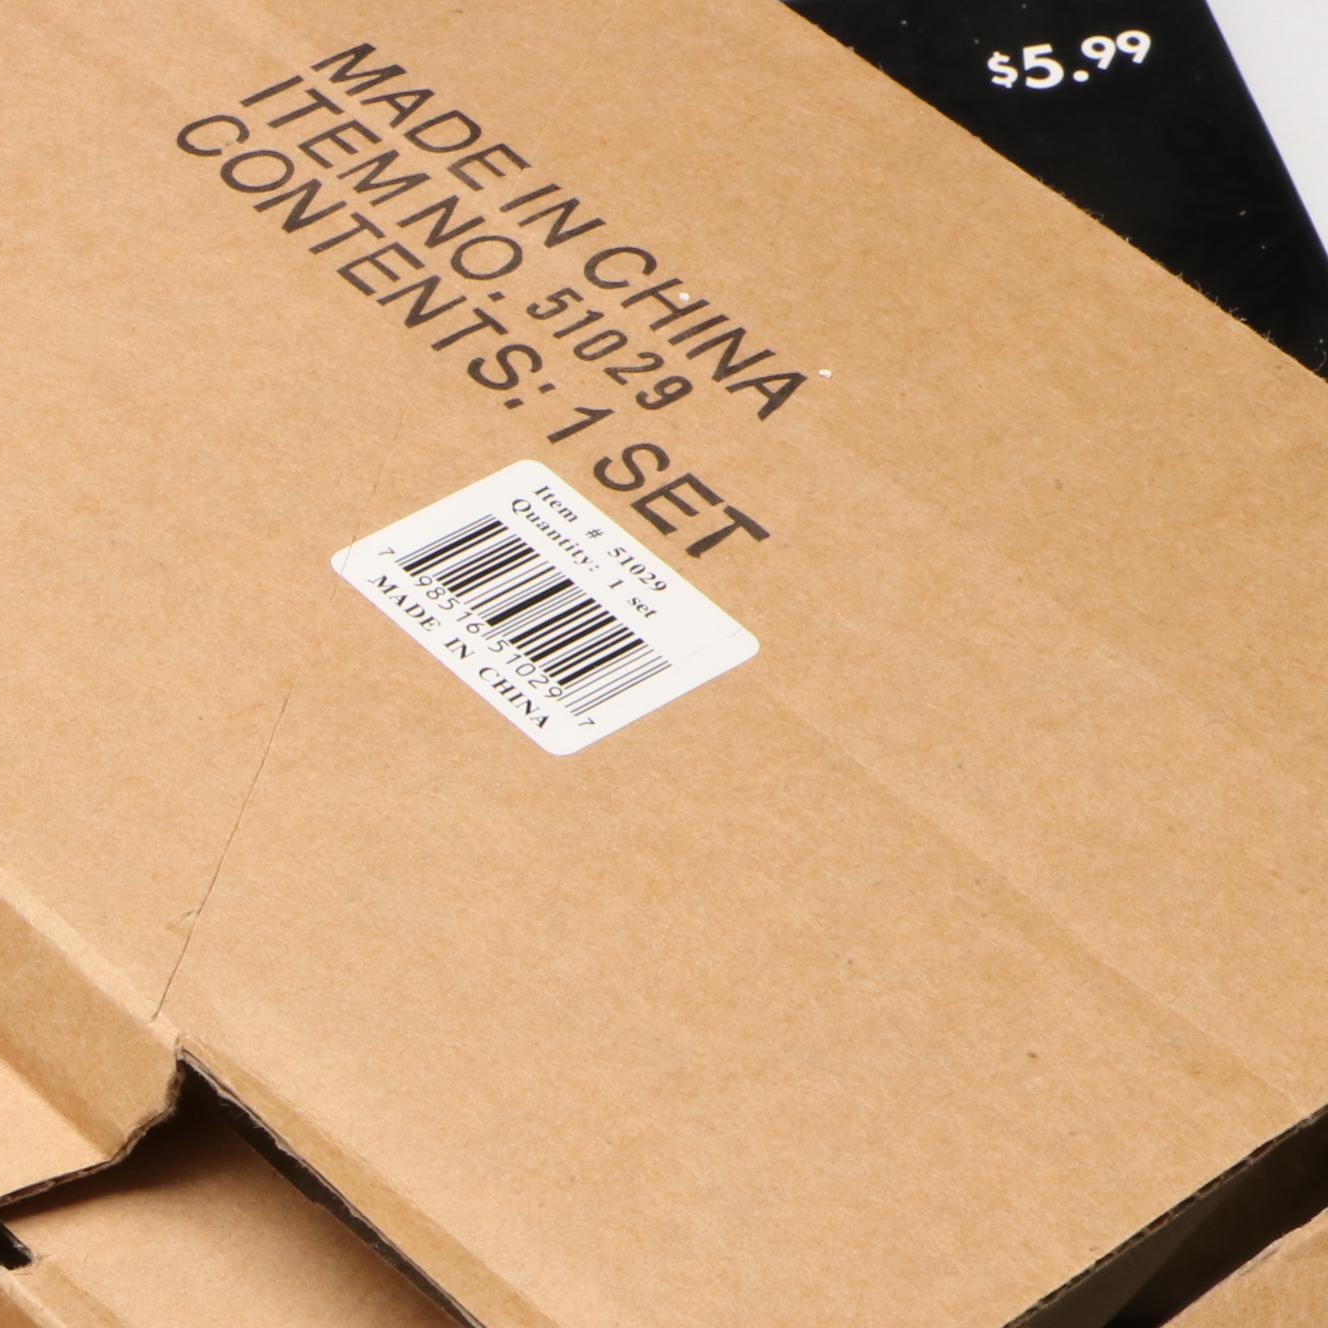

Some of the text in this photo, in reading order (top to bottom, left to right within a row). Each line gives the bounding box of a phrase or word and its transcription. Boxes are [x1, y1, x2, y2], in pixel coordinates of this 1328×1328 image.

[987, 30, 1151, 89] $5.99
[239, 75, 693, 410] ITEM NO. 51029
[311, 42, 807, 421] MADE IN CHINA
[176, 114, 770, 558] CONTENTS: 1 SET
[512, 498, 659, 619] Quantity: 1 set
[534, 484, 668, 595] Item # 51029
[368, 574, 549, 729] MADE IN CHINA
[414, 575, 482, 635] 98516
[488, 640, 565, 700] 51029
